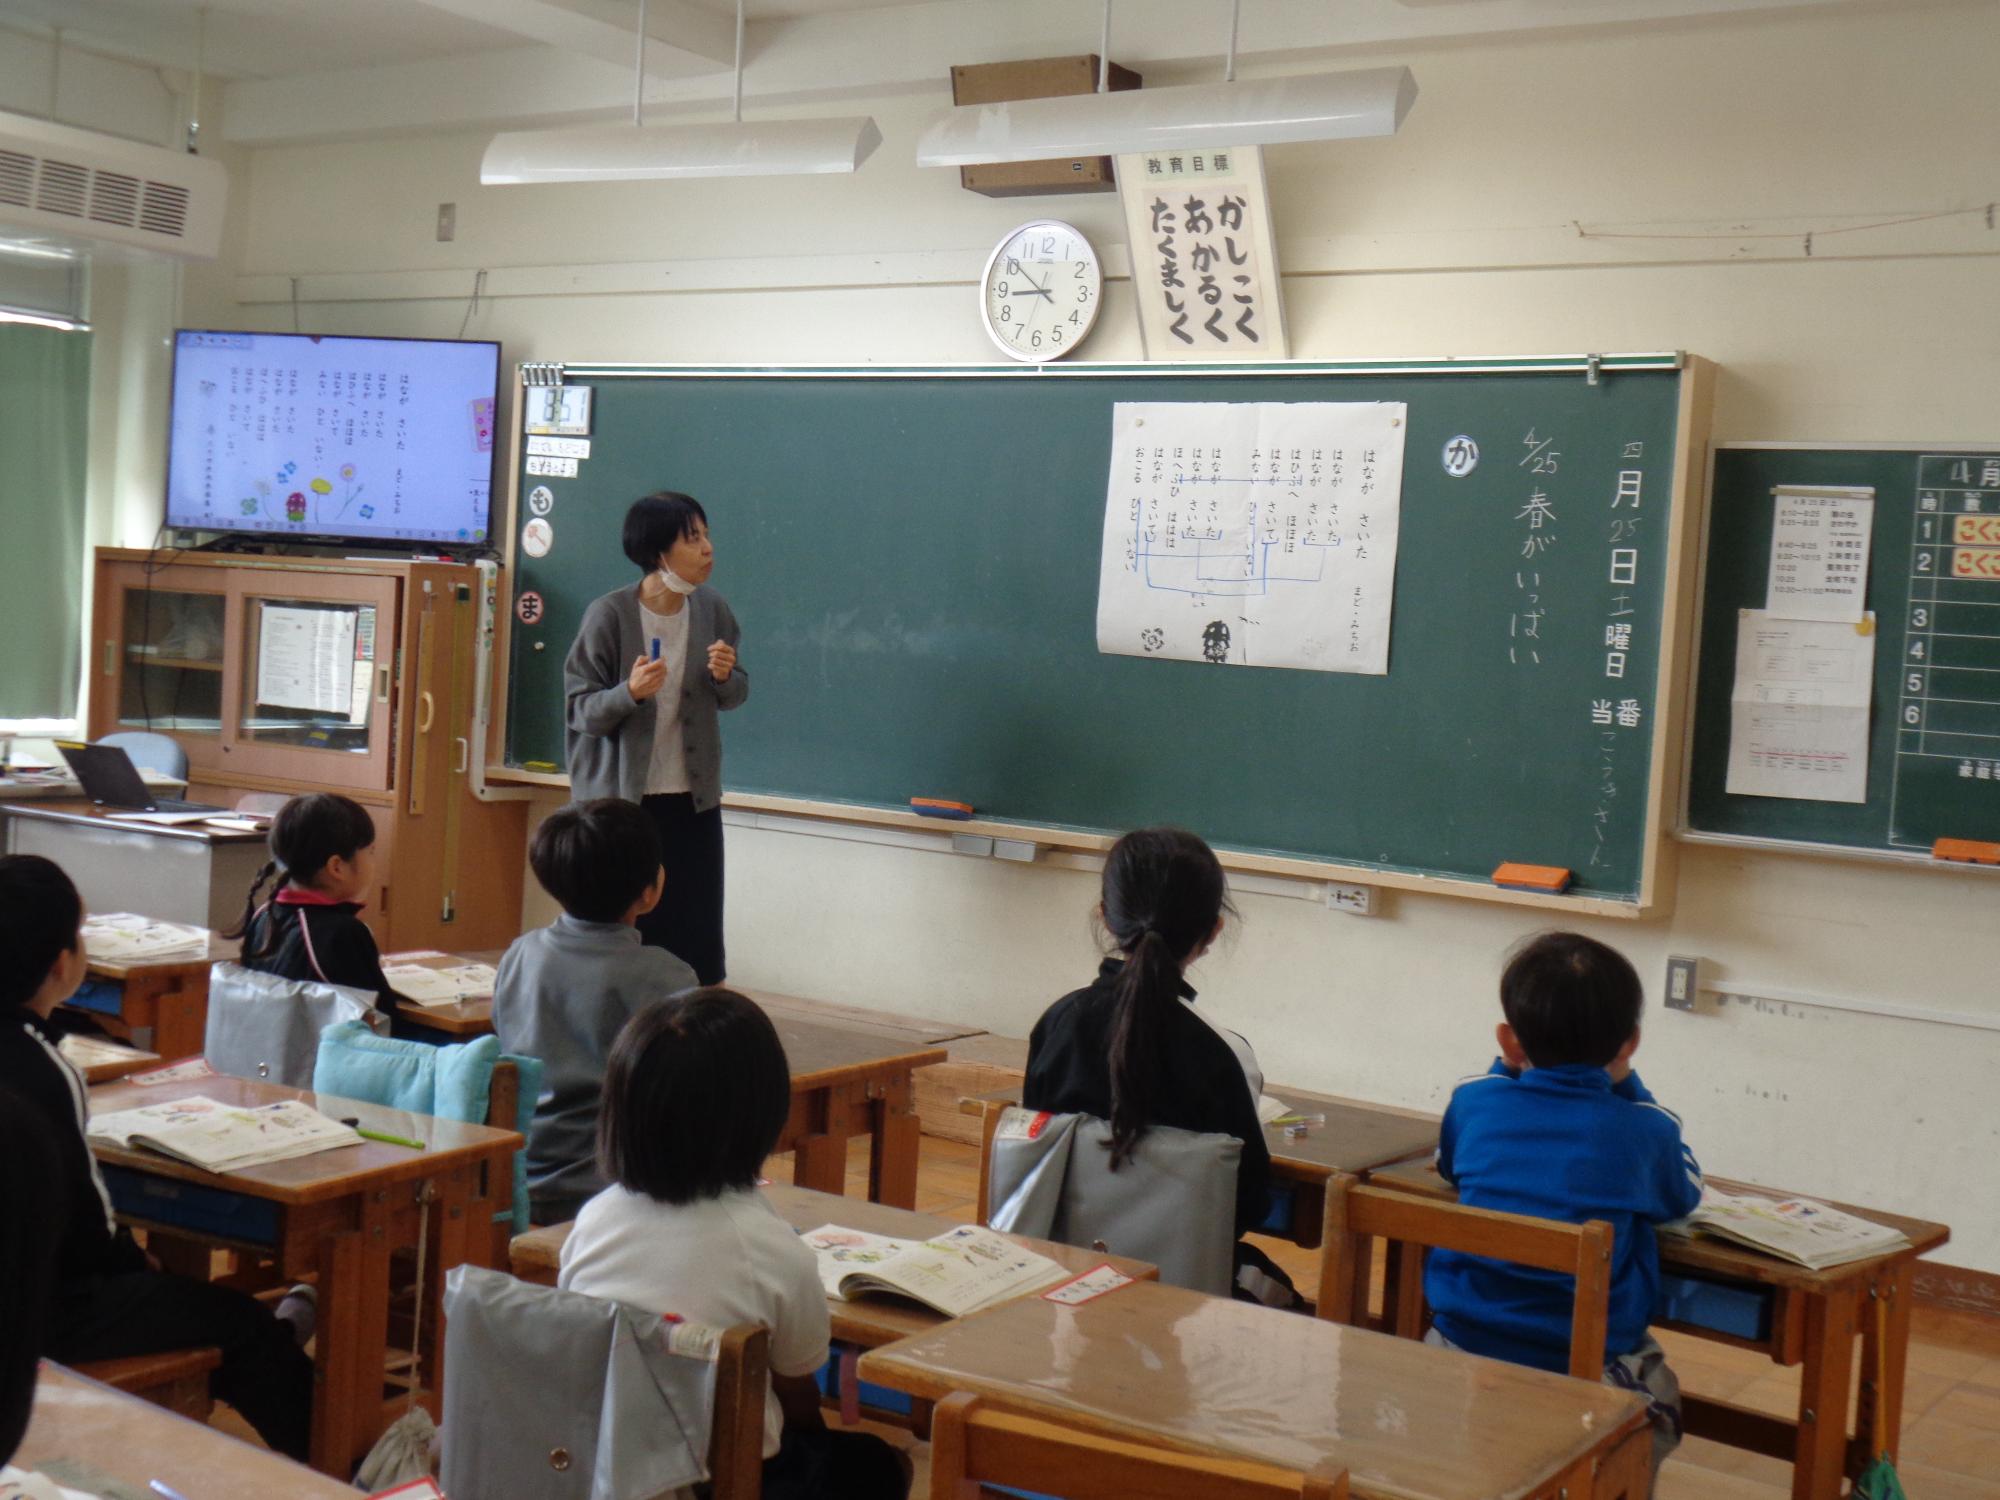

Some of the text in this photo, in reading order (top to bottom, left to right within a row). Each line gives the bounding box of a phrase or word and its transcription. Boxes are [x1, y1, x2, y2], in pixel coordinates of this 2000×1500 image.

[1148, 154, 1229, 174] 教育目標
[1023, 242, 1034, 258] 11
[1042, 237, 1056, 254] 12
[1074, 261, 1086, 278] 2
[1150, 196, 1194, 344] たくましく
[1184, 194, 1229, 342] あかるく
[1217, 194, 1259, 343] かしこく
[998, 281, 1008, 298] 9
[1077, 285, 1088, 302] 3
[1000, 305, 1011, 322] 8
[1068, 309, 1079, 326] 4
[1015, 323, 1025, 340] 7
[1031, 330, 1042, 347] 6
[1051, 325, 1063, 342] 5
[1448, 439, 1477, 469] か
[1517, 426, 1562, 475] 4/25
[1152, 448, 1164, 483] はなが
[1270, 448, 1281, 487] はなが
[1288, 449, 1301, 498] はひふへ
[1361, 449, 1377, 495] はなが
[532, 489, 550, 513] も
[1186, 448, 1202, 536] はなが さいた
[1205, 448, 1222, 537] はなが さいた
[1306, 449, 1322, 541] はなが さいた
[1327, 449, 1344, 542] はなが さいた
[1355, 513, 1371, 559] さいた
[1922, 520, 1932, 539] 1
[1917, 552, 1932, 571] 2
[521, 595, 539, 619] ま
[1911, 608, 1928, 627] 3
[1910, 641, 1924, 659] 4
[1907, 673, 1923, 692] 5
[1591, 698, 1642, 728] 当番
[1904, 705, 1920, 724] 6
